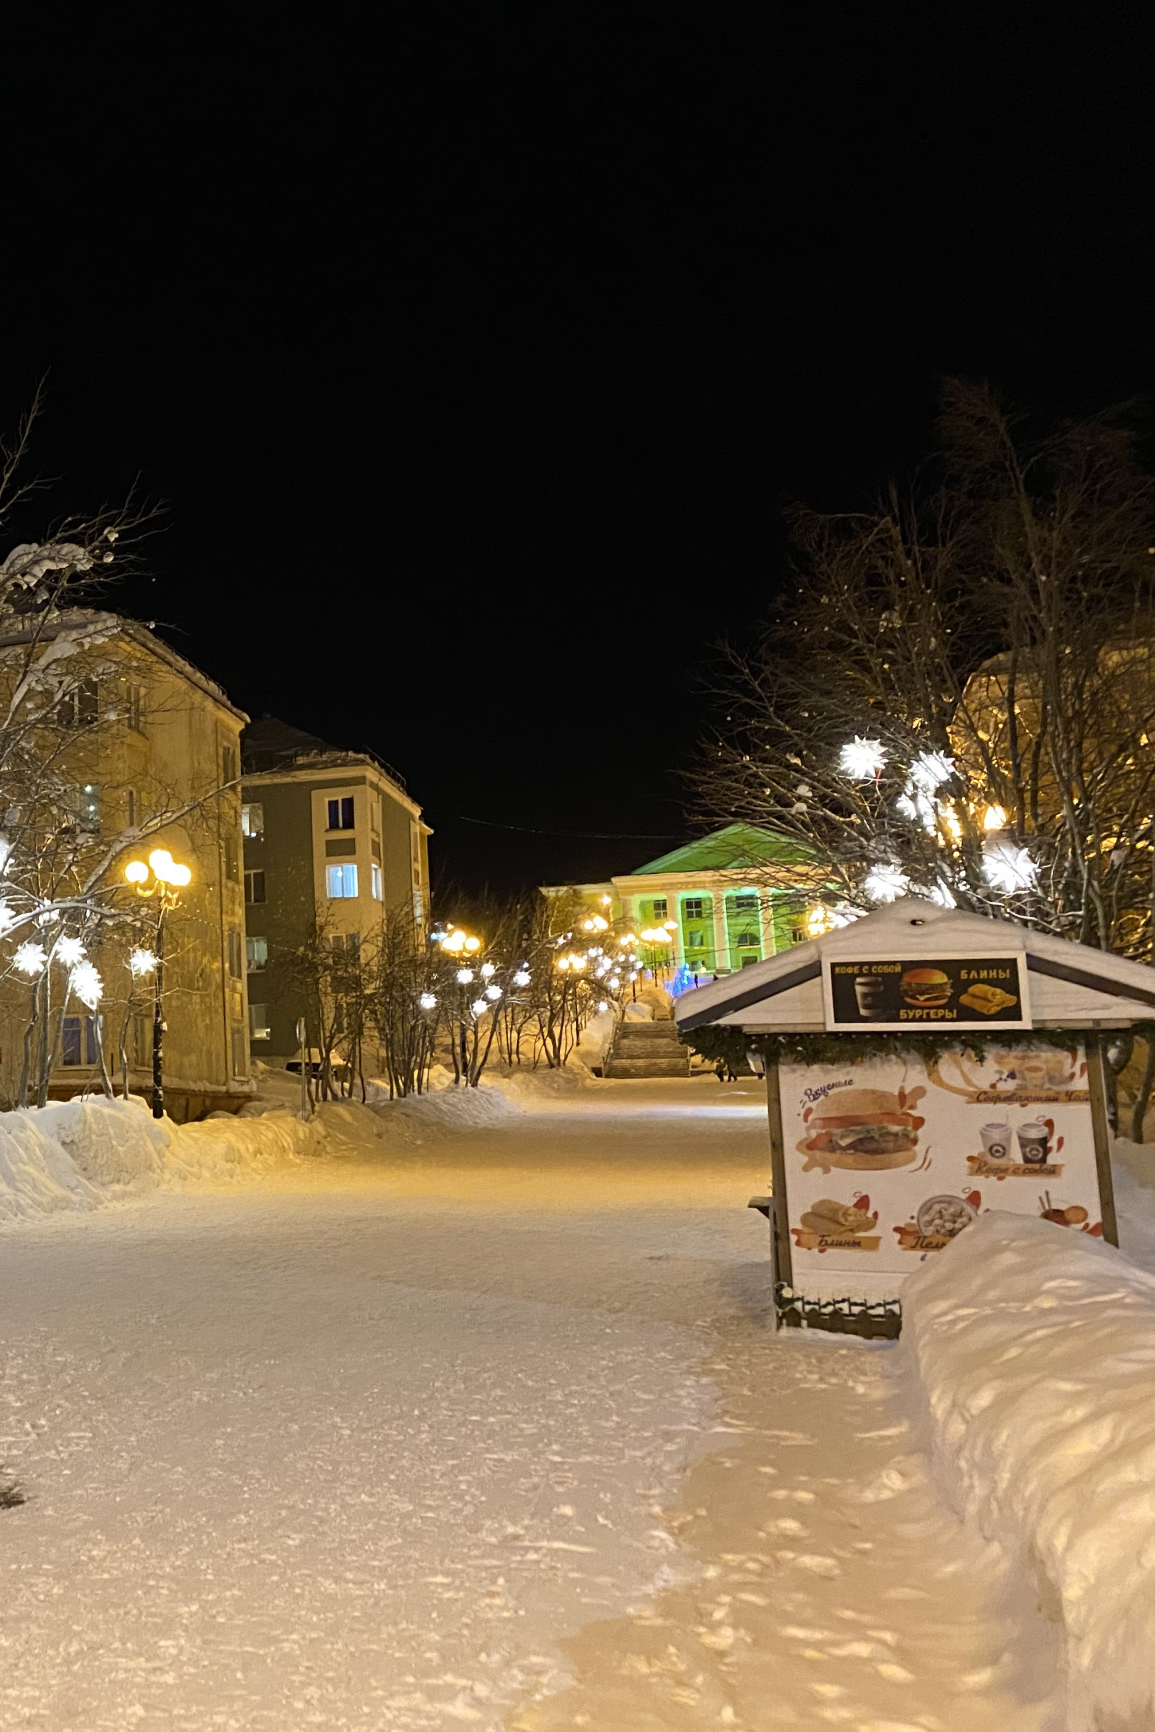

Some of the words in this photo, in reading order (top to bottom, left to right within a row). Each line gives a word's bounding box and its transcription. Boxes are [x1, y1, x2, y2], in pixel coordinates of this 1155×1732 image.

[834, 965, 859, 974] КОФЕ
[862, 965, 869, 973] С
[871, 962, 902, 973] СОБОЙ
[960, 968, 1011, 980] БЛИНЫ
[899, 1008, 957, 1019] БУРГЕРЫ
[804, 1079, 854, 1102] Вкусные
[818, 1234, 862, 1248] Блины
